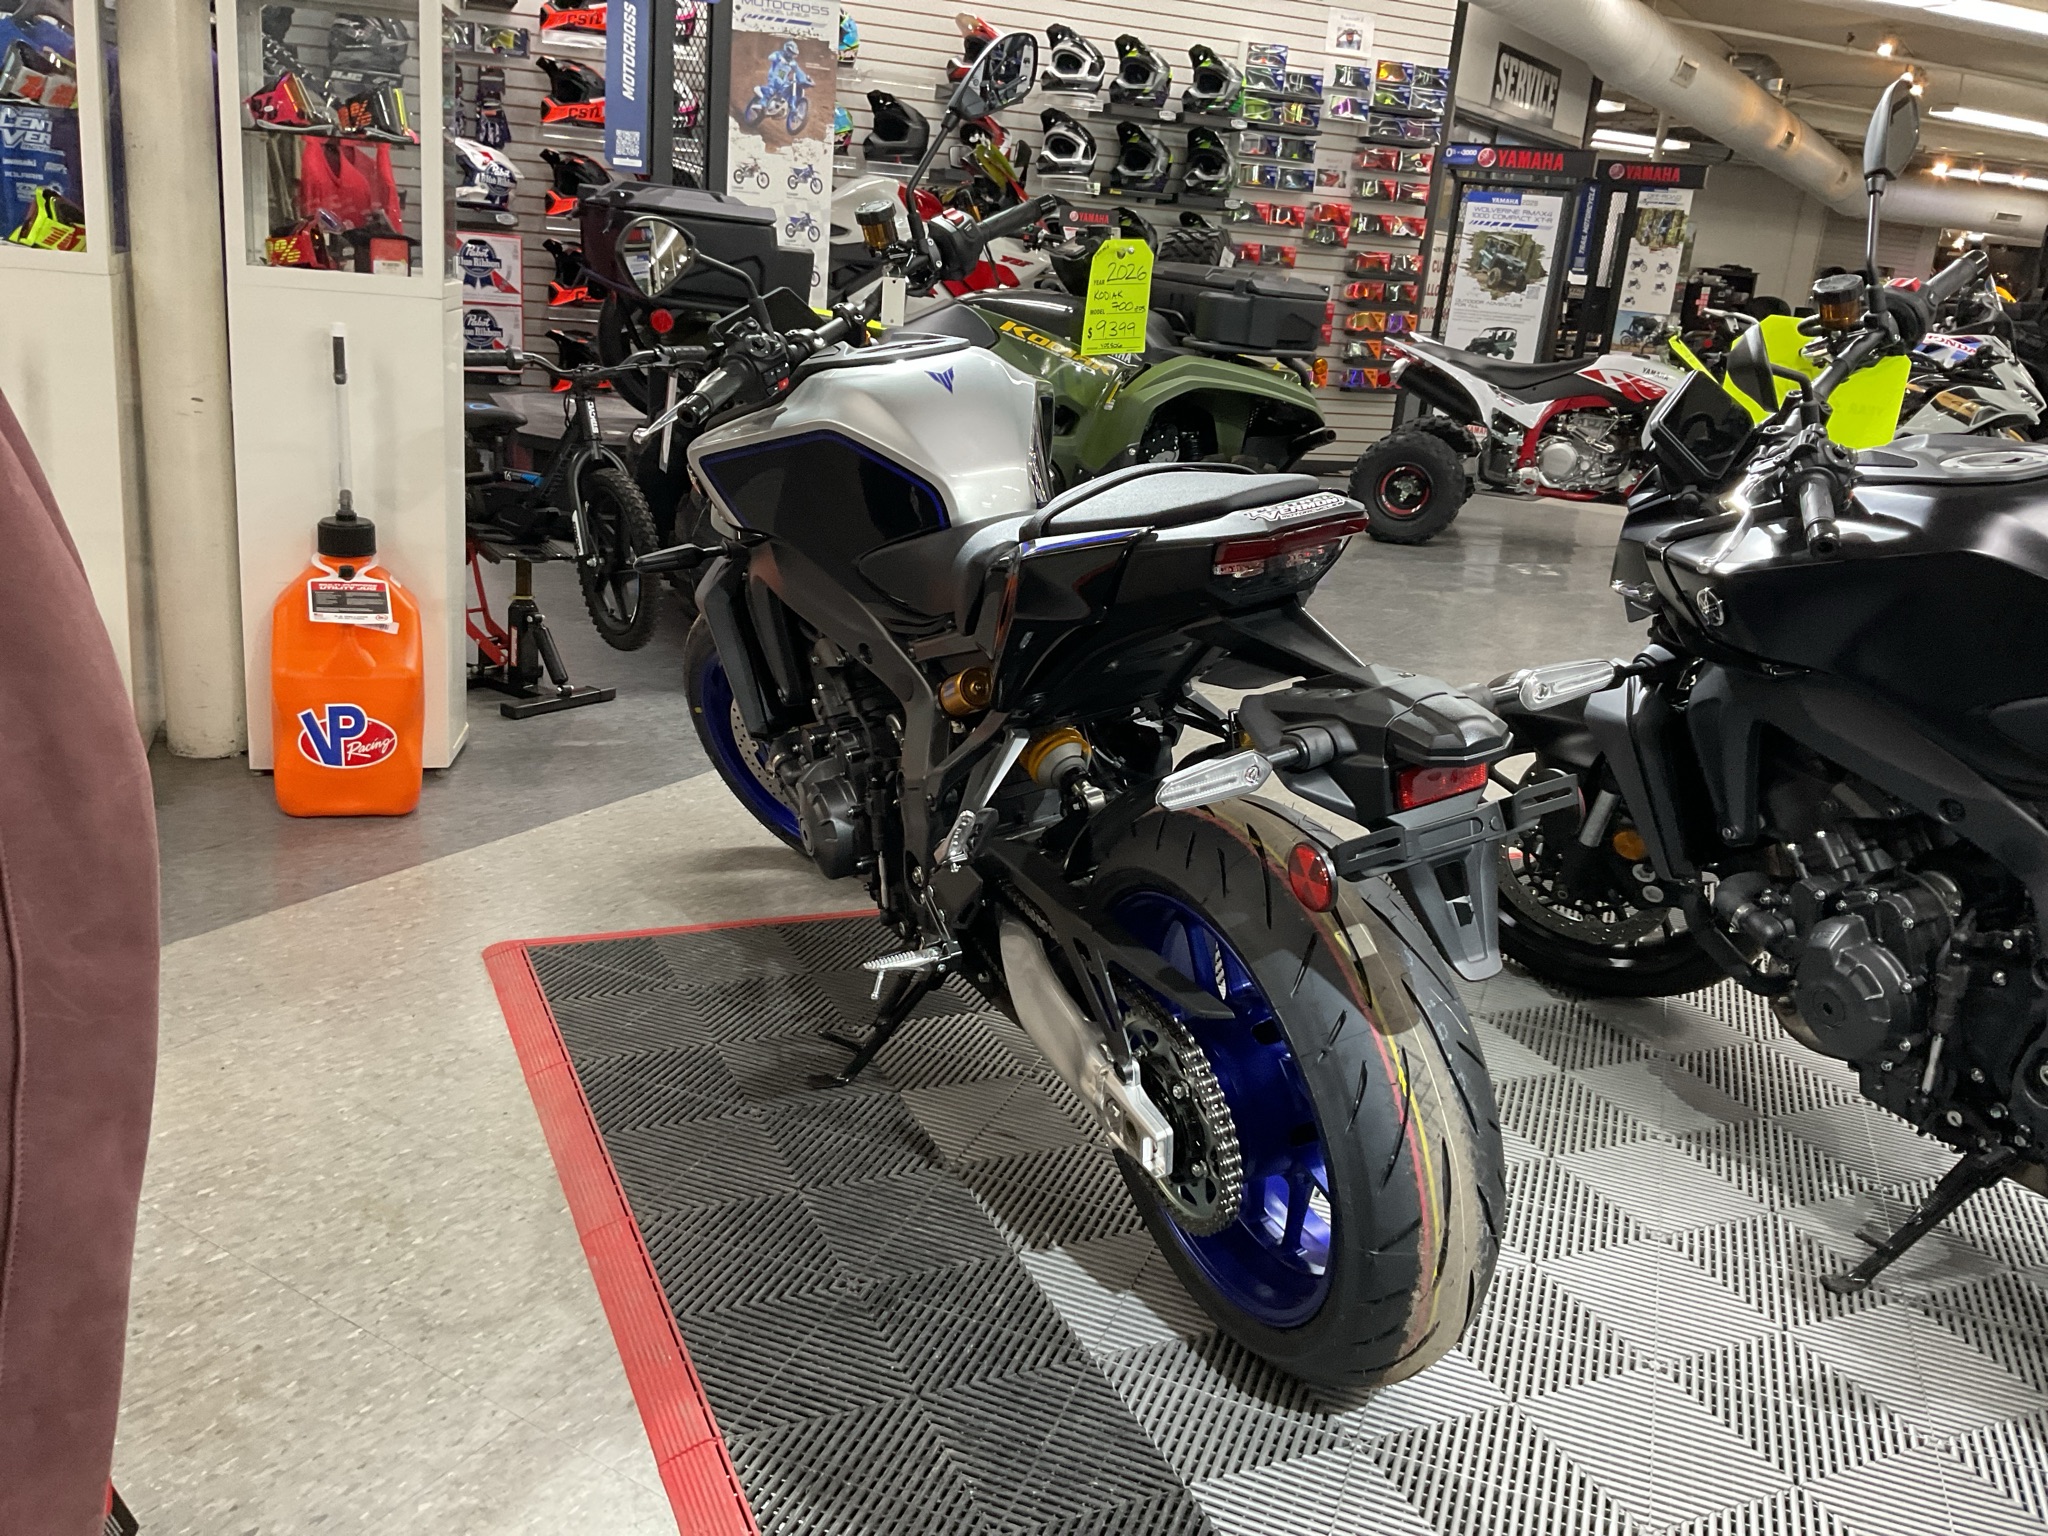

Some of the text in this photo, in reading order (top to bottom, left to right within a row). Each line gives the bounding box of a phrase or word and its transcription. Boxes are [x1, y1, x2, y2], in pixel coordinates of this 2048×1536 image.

[622, 1, 637, 101] MOTOCROSS
[1495, 52, 1559, 119] SERVICE
[1498, 149, 1564, 172] YAMAHA
[1626, 165, 1680, 182] YAMAHA
[1491, 197, 1519, 205] YAMAHA
[1079, 212, 1109, 224] YAMAHA
[1474, 206, 1520, 215] WOLVERINE
[1492, 213, 1530, 222] COMPACT
[1579, 186, 1597, 255] TRAIL MOTORCYCLE
[1107, 261, 1148, 283] 2026
[1112, 301, 1134, 312] 700
[1486, 300, 1523, 309] ADVENTURE
[467, 313, 491, 327] Pabst
[297, 704, 367, 767] VP
[346, 737, 396, 761] Racing
